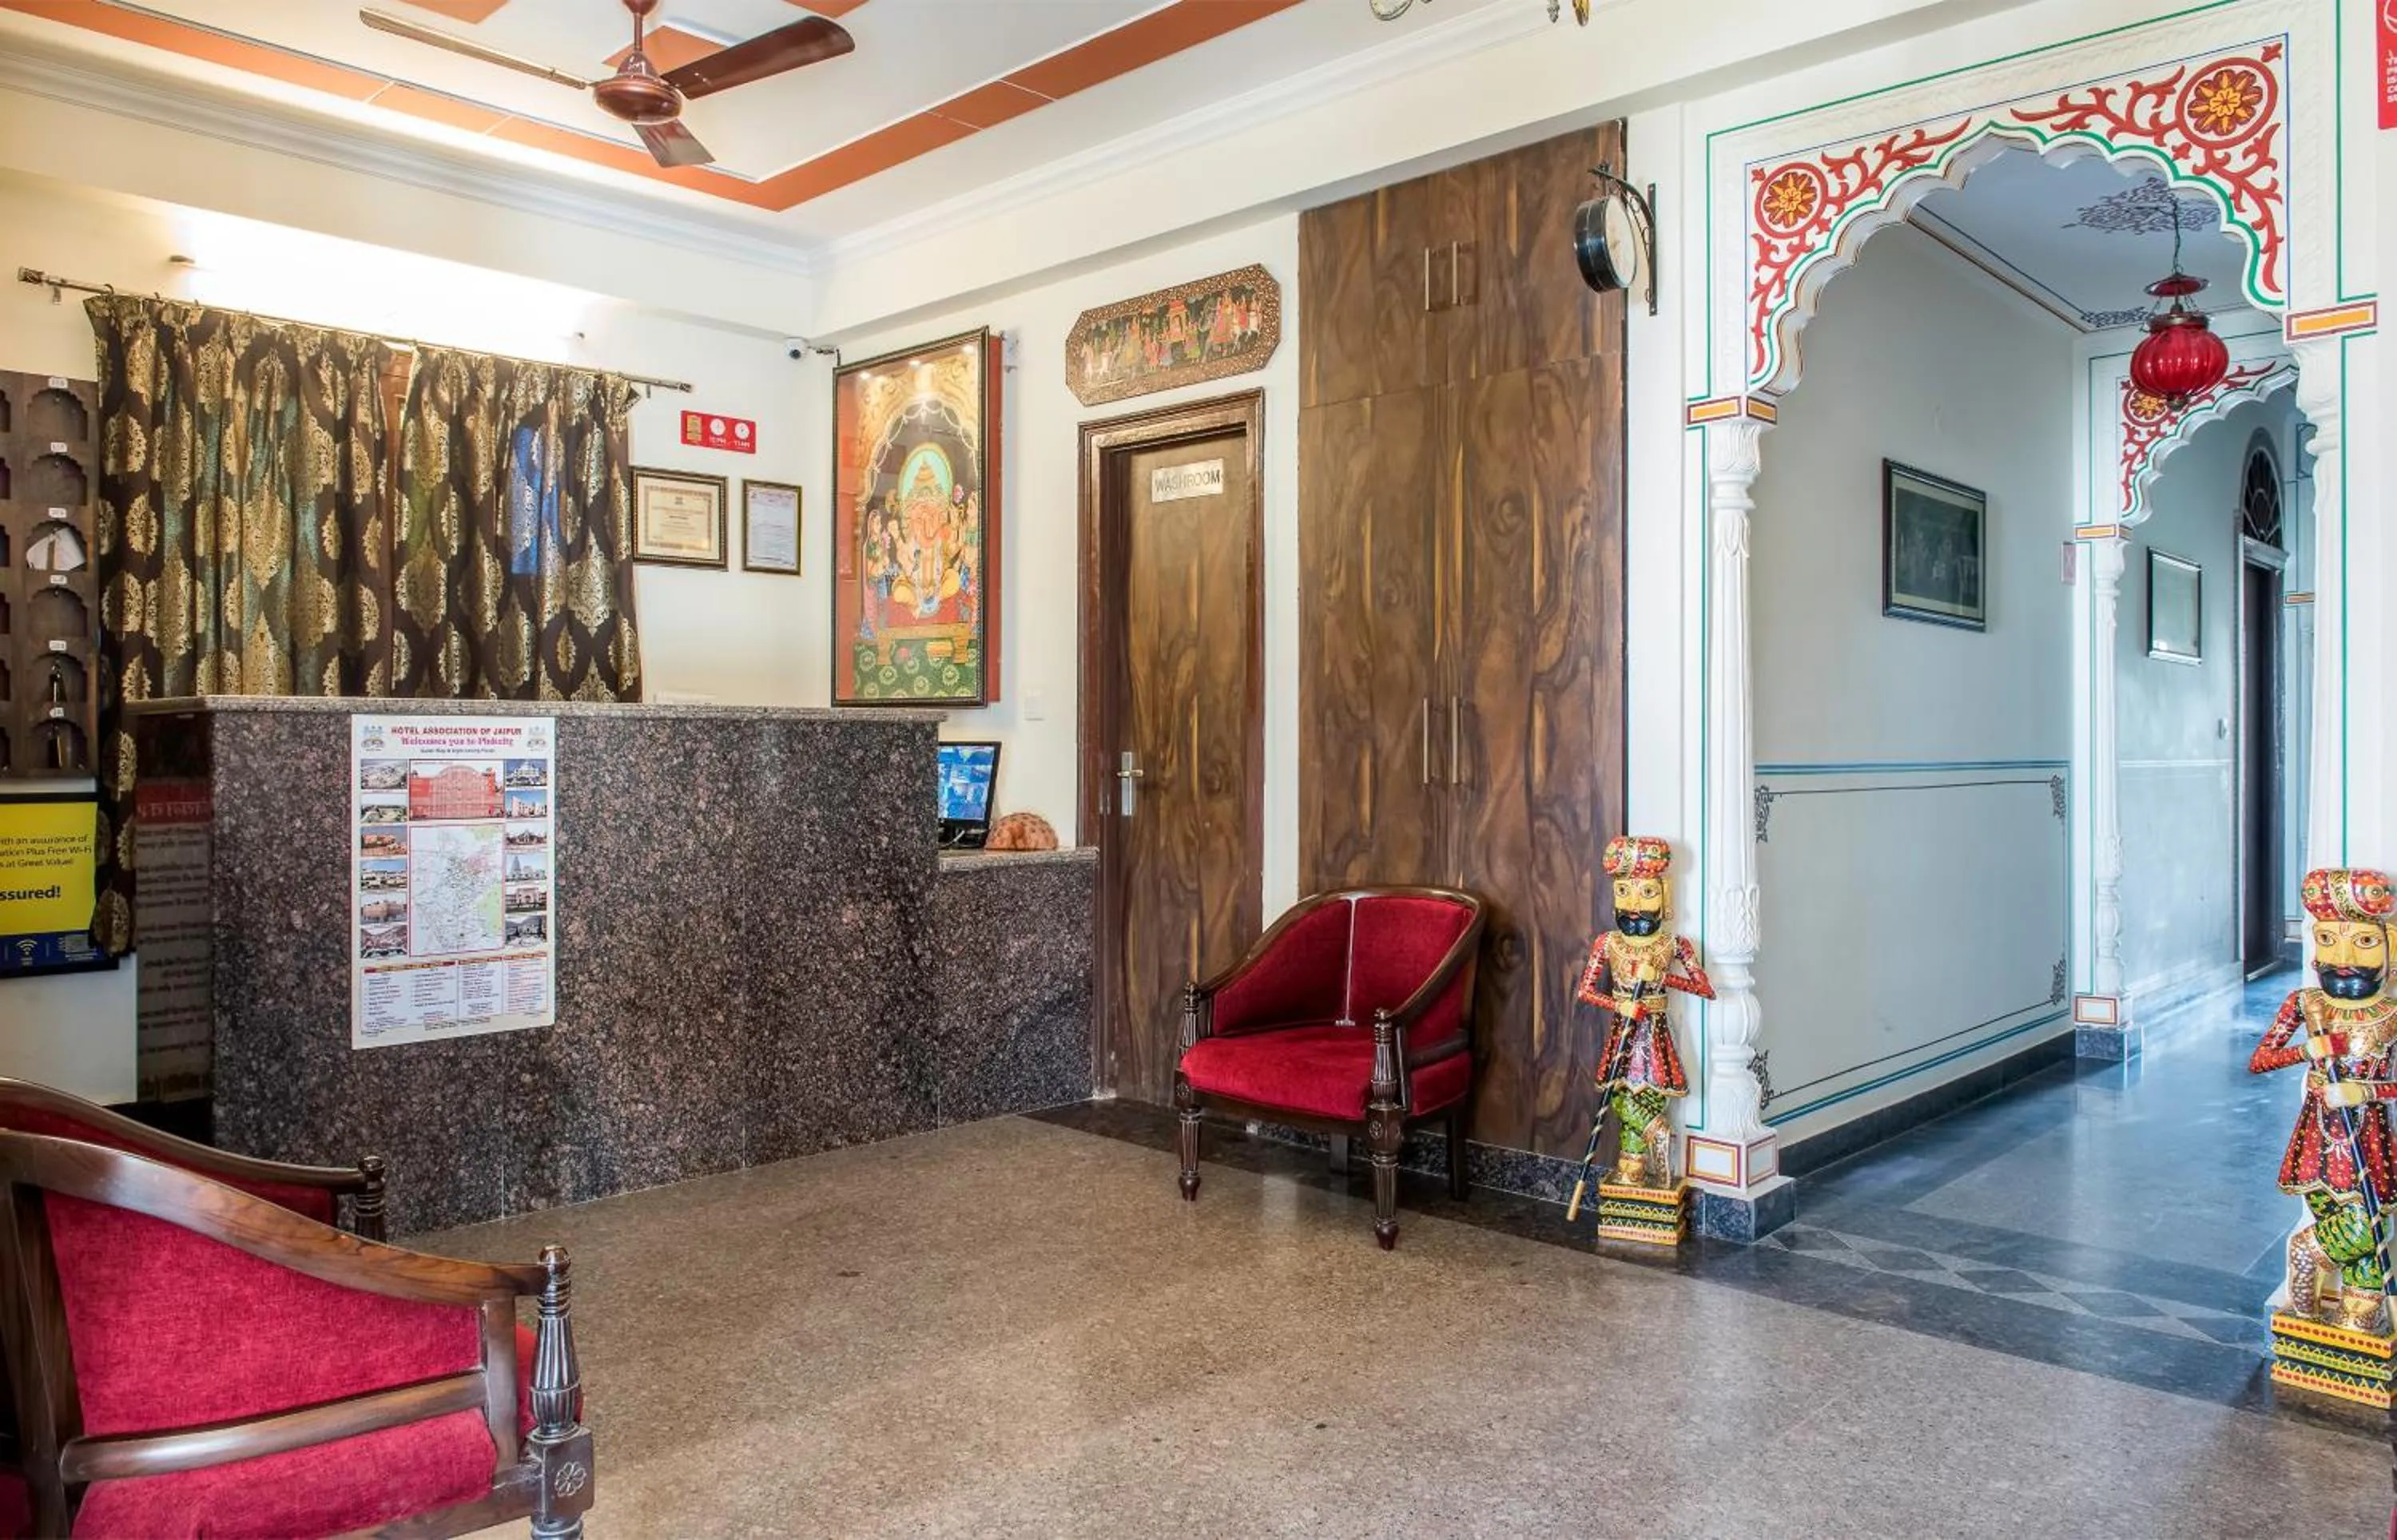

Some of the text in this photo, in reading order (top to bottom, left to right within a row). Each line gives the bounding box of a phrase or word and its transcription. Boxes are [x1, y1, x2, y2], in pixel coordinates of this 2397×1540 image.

[1155, 469, 1220, 493] WASHROOM
[423, 726, 478, 735] ASSOCIATION
[78, 834, 88, 843] of
[69, 845, 92, 854] Wi-Fi
